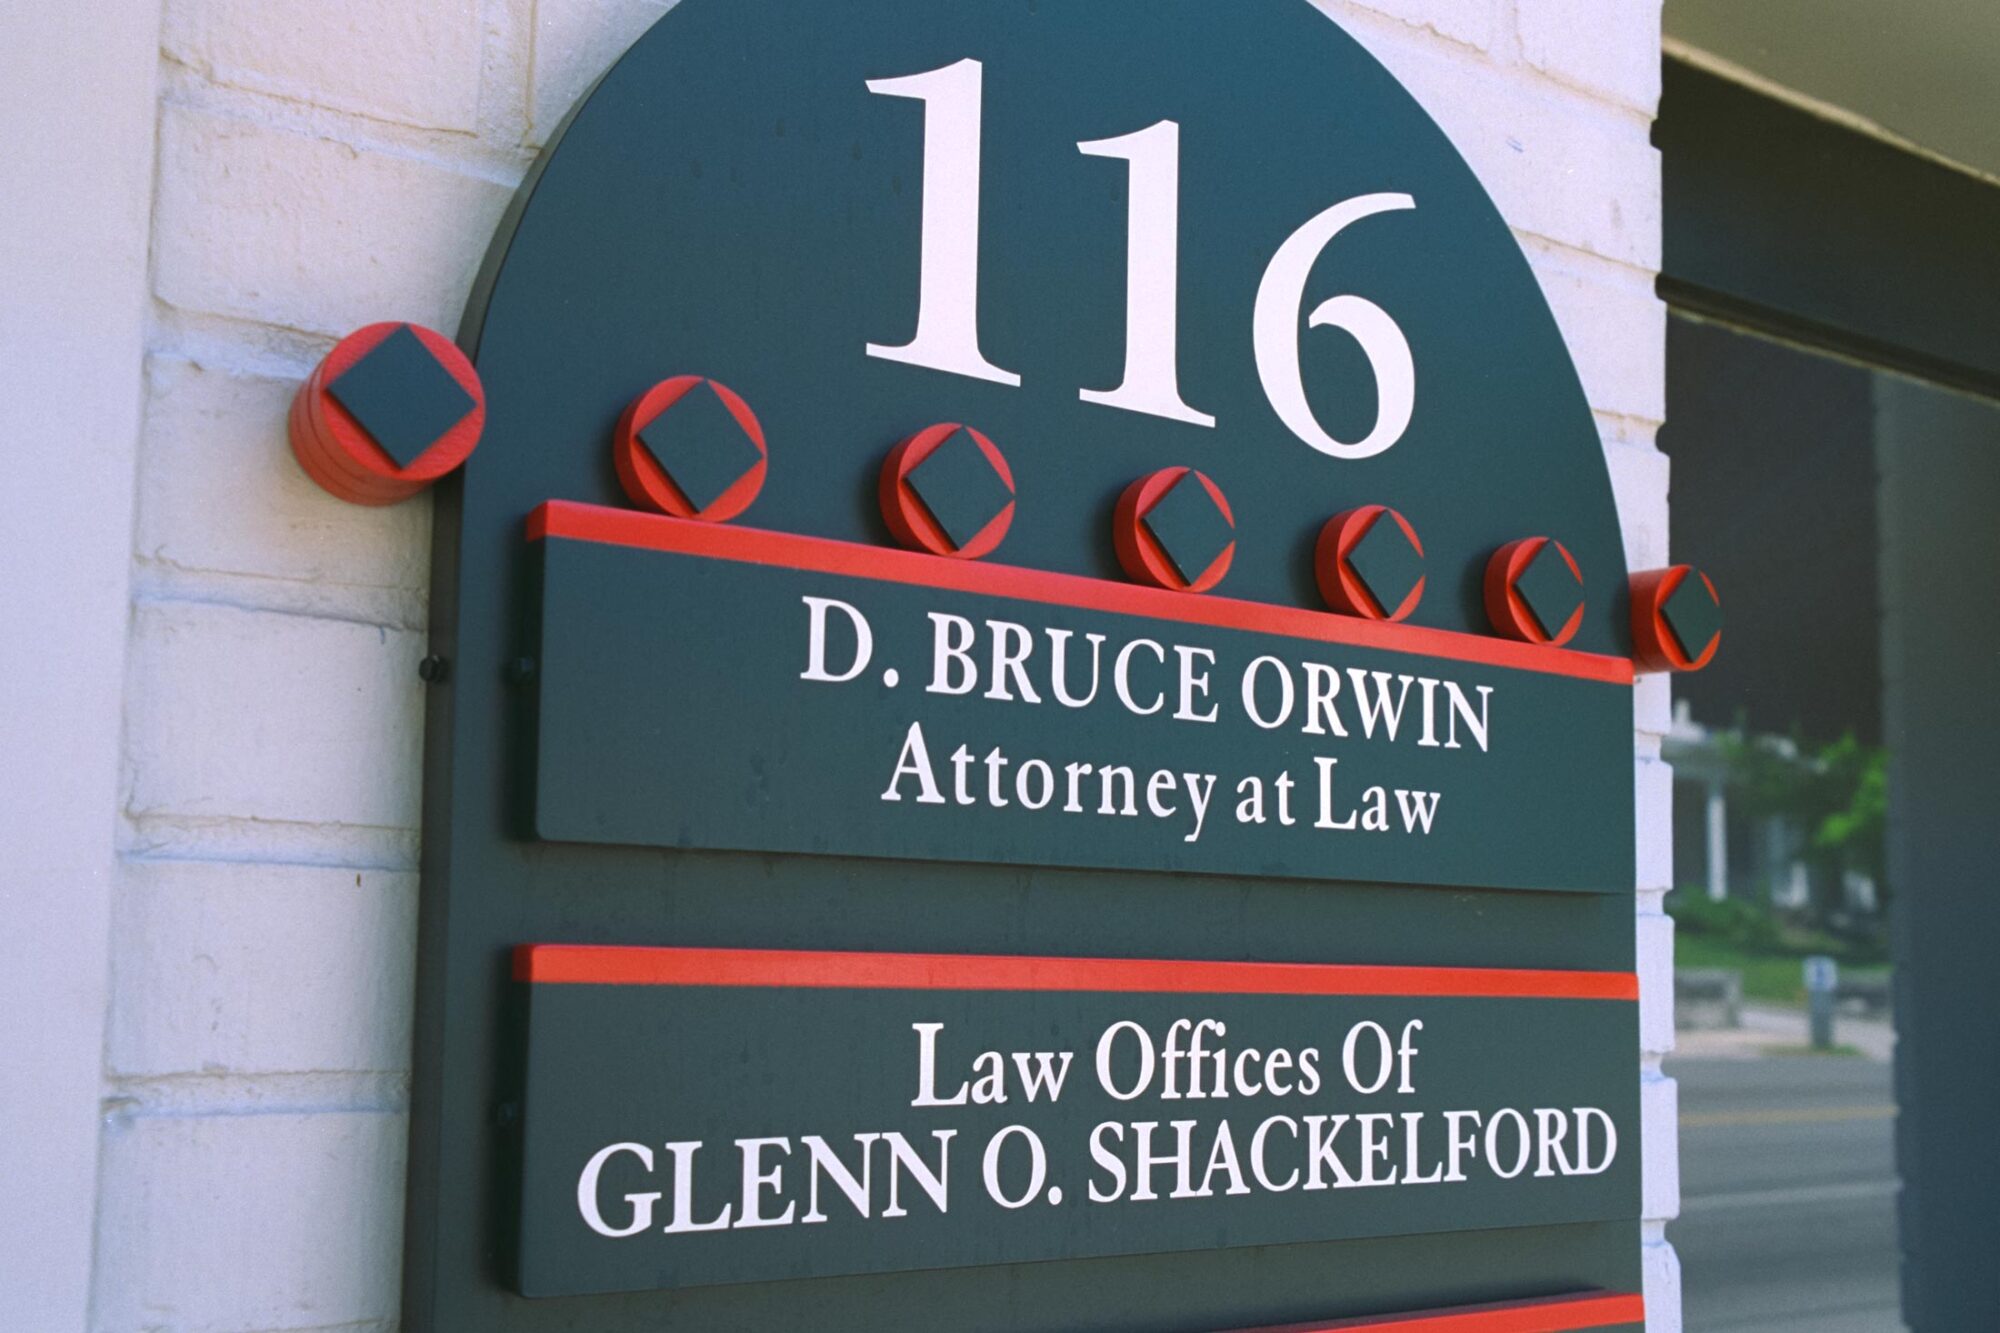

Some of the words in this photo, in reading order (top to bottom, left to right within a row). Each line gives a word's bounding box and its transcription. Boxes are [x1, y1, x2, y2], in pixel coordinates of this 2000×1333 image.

[866, 58, 1415, 459] 116
[801, 596, 898, 687] D.
[926, 612, 1218, 722] BRUCE
[1242, 656, 1493, 752] ORWIN
[881, 722, 1216, 842] Attorney
[1236, 771, 1295, 826] at
[1314, 757, 1440, 835] Law
[912, 1022, 1073, 1106] Law
[1096, 1019, 1320, 1100] Offices
[1343, 1020, 1423, 1094] Of
[578, 1130, 957, 1237] GLENN
[983, 1125, 1062, 1209] O.
[1089, 1108, 1617, 1203] SHACKELFORD
